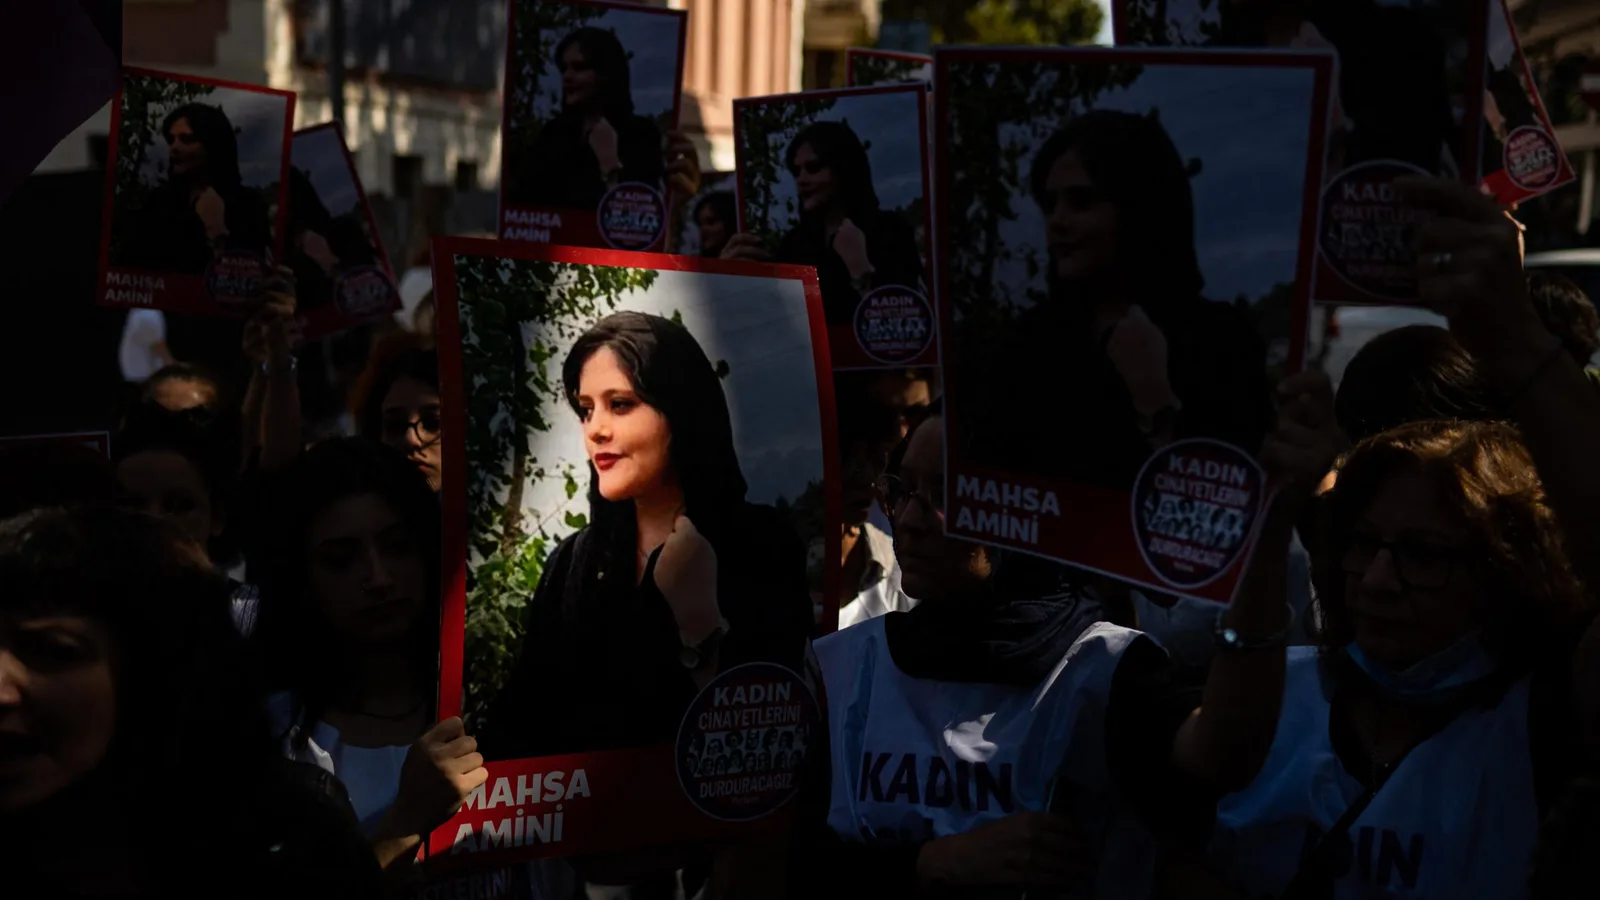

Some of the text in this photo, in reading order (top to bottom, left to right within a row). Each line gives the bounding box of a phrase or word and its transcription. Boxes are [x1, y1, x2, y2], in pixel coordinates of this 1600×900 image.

[1343, 181, 1394, 202] KAD
[504, 208, 562, 229] MAHSA
[503, 225, 550, 244] AMİNİ
[105, 271, 165, 292] MAHSA
[1168, 452, 1248, 486] KADIN
[956, 473, 1062, 518] MAHSA
[955, 505, 1040, 546] AMİNİ
[713, 680, 793, 708] KADIN
[698, 702, 801, 730] CİNAYETLERİNİ
[457, 768, 592, 813] MAHSA
[859, 751, 1015, 813] KADIN
[450, 803, 565, 855] AMİNİ
